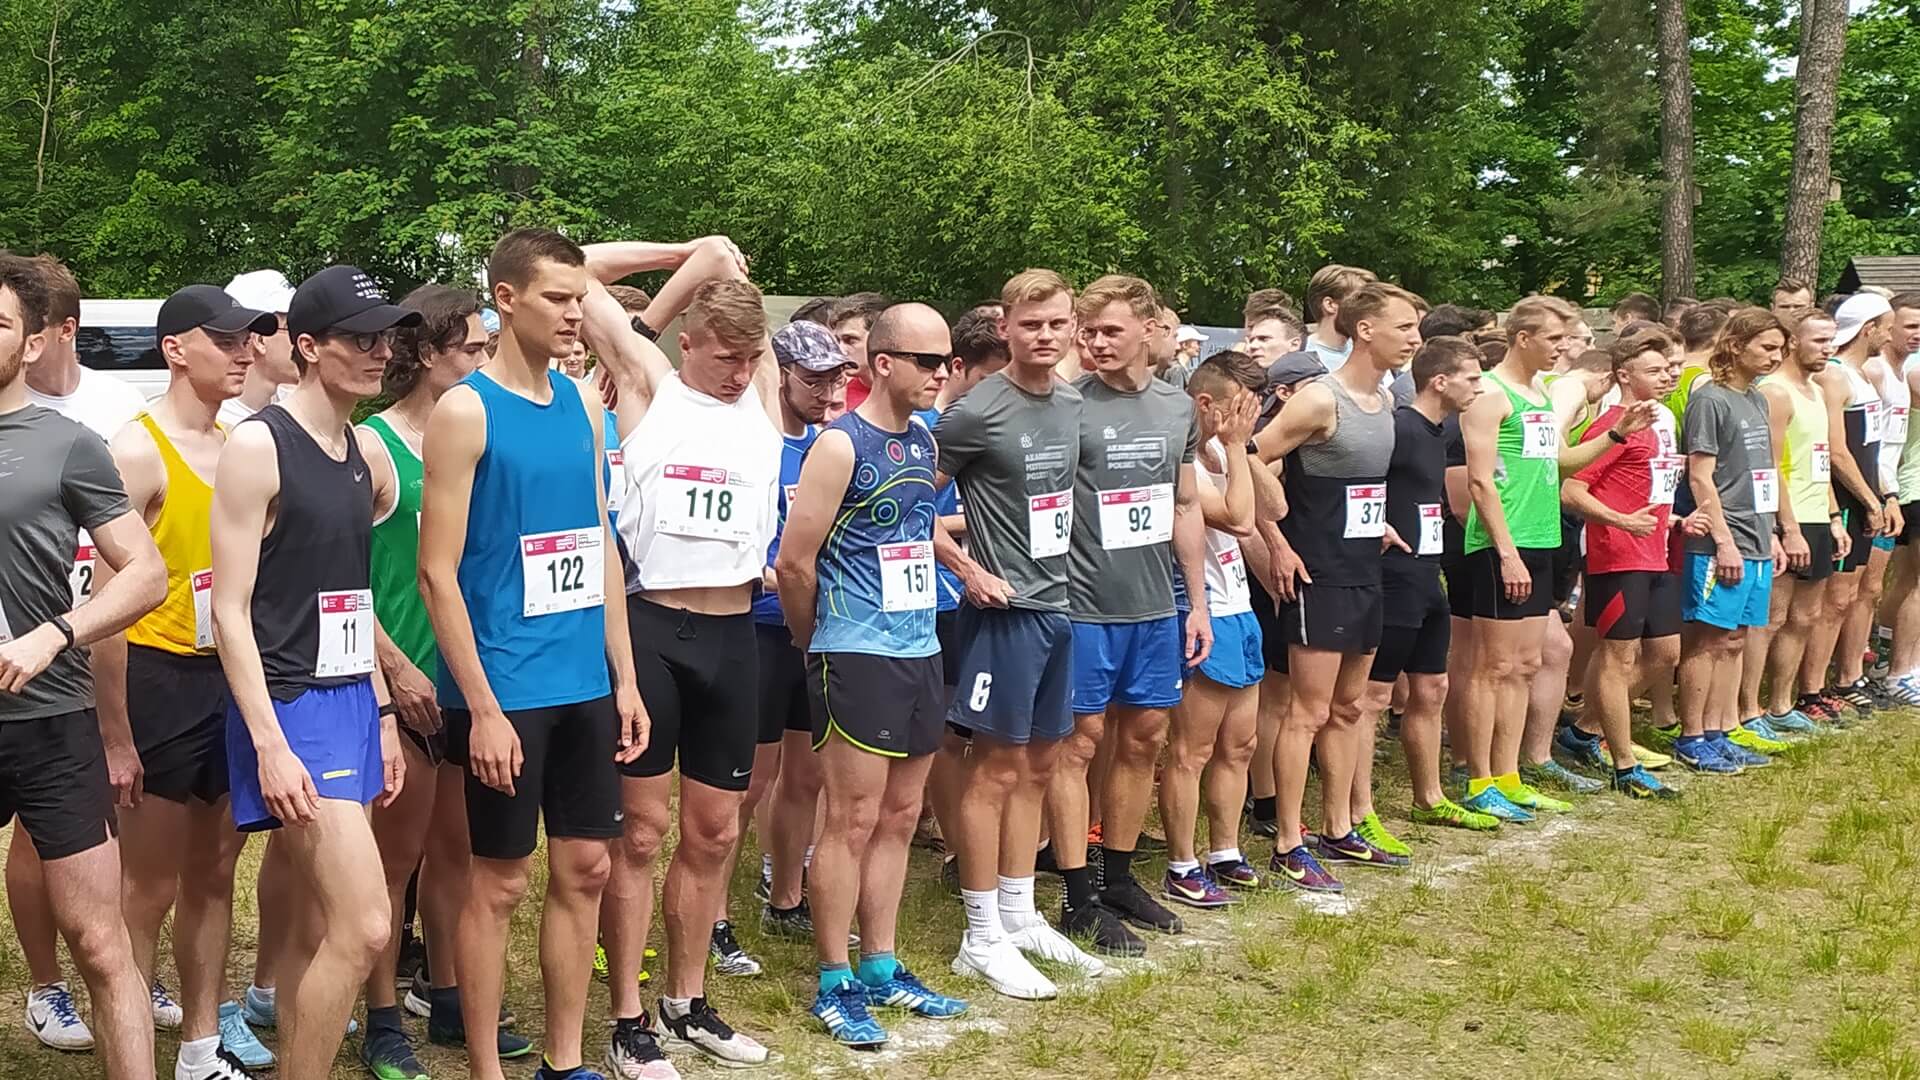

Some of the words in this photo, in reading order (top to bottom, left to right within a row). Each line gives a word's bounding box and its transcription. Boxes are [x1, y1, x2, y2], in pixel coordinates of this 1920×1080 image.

[686, 487, 733, 523] 118
[1128, 505, 1152, 533] 92
[1055, 510, 1069, 539] 93
[547, 555, 584, 594] 122
[903, 564, 928, 593] 157
[342, 618, 356, 655] 11
[970, 672, 992, 713] 6
